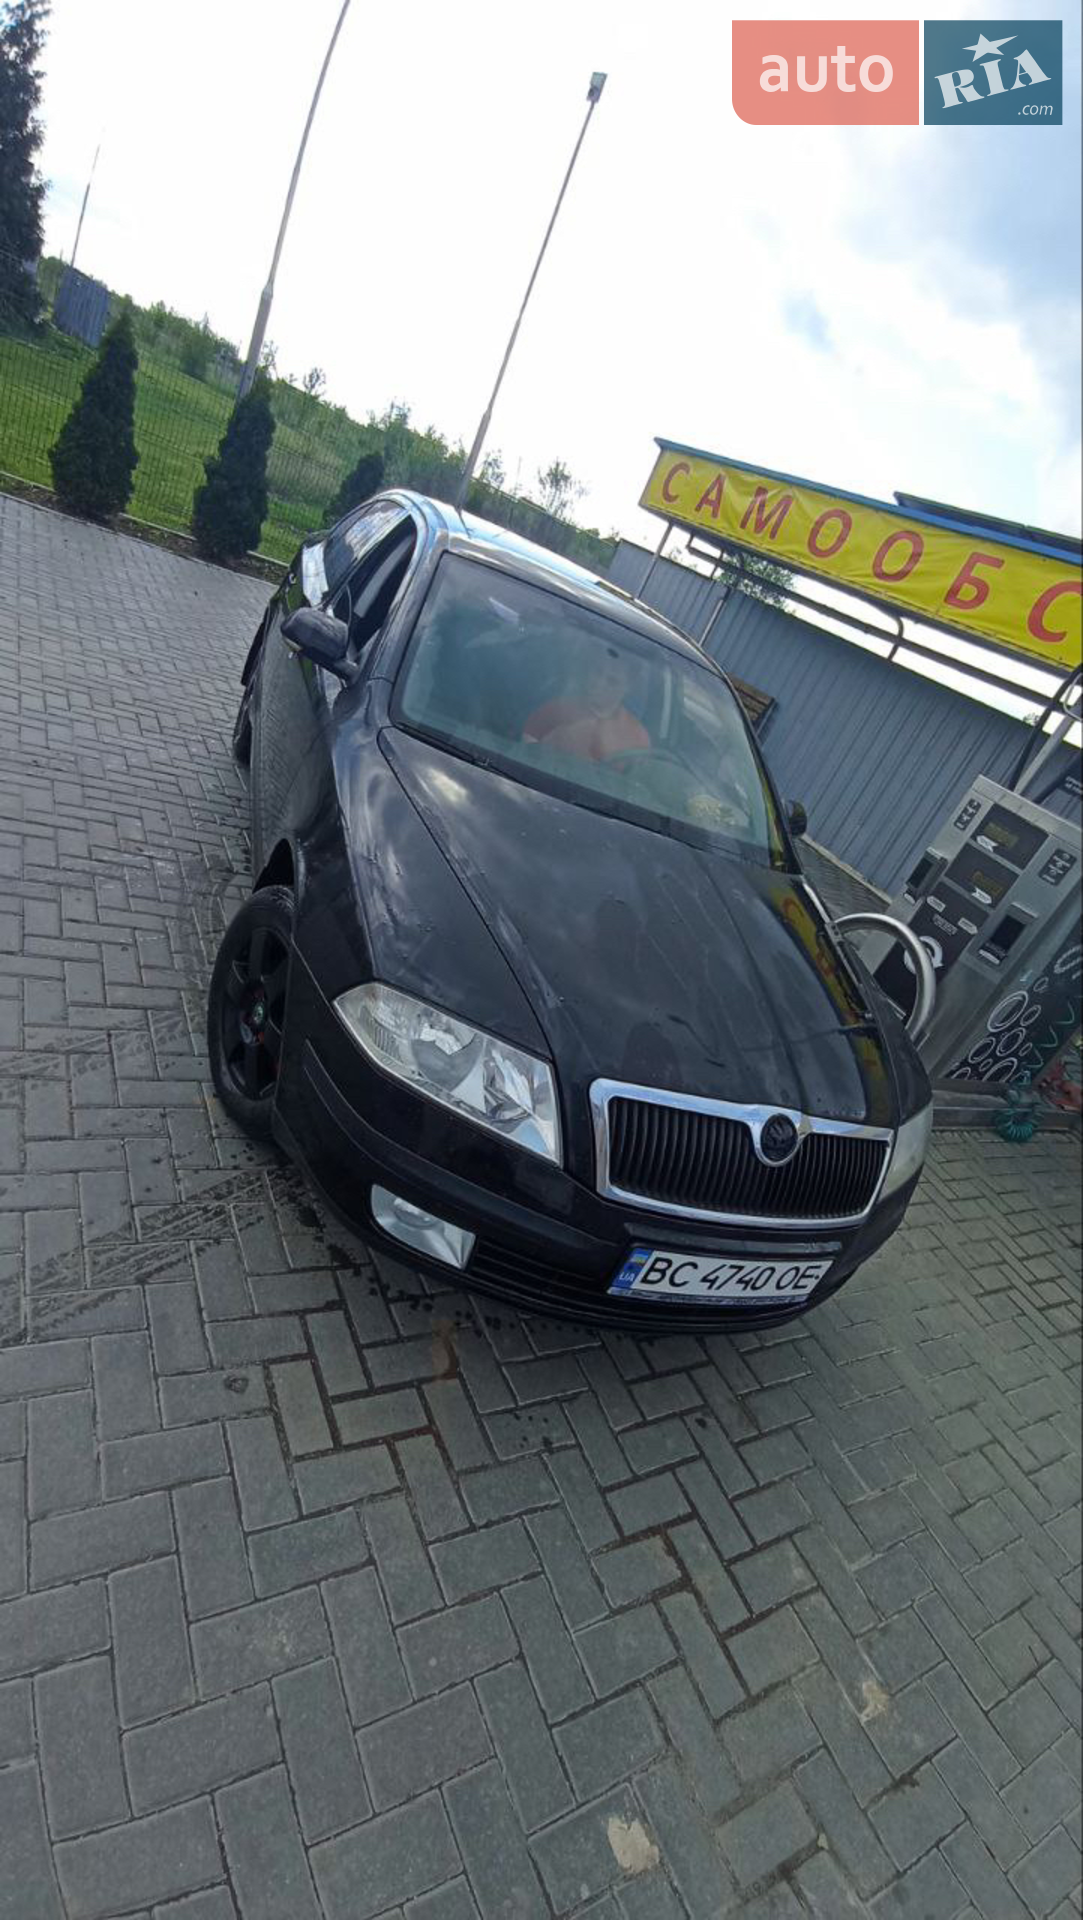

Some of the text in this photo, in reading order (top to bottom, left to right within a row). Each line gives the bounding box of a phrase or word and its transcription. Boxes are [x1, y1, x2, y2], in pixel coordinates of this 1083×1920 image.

[618, 1271, 635, 1282] UA
[642, 1257, 822, 1291] BC 4740 OE
